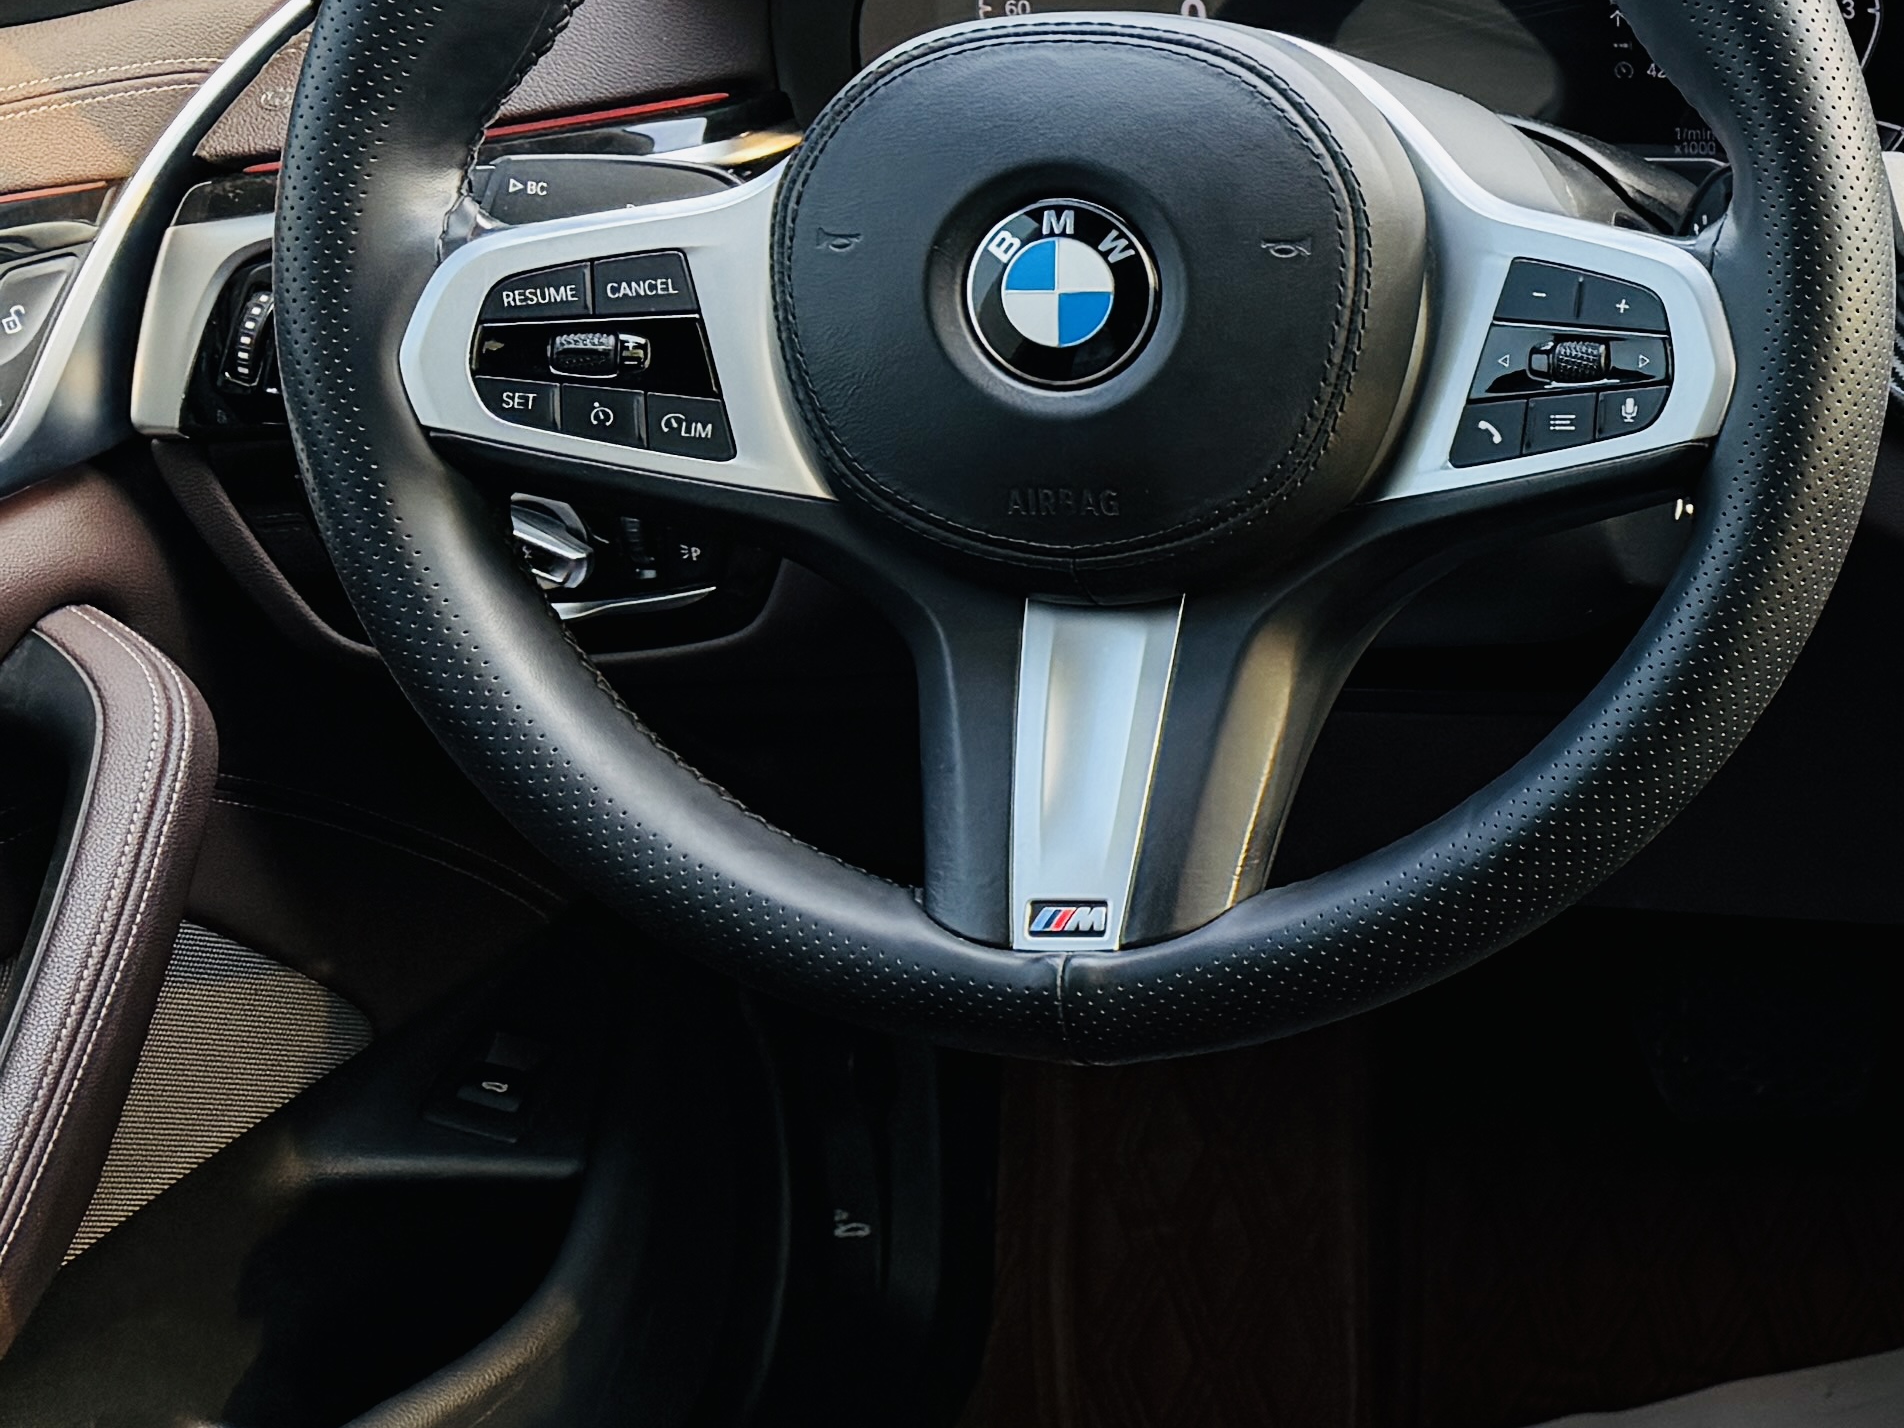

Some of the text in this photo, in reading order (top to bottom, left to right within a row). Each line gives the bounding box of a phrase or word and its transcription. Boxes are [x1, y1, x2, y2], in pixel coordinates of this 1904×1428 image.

[1005, 0, 1031, 16] 60
[1842, 0, 1855, 19] 3
[526, 181, 548, 196] BC
[986, 209, 1136, 264] BMW
[502, 284, 579, 308] RESUME
[606, 278, 679, 299] CANCEL
[502, 392, 536, 410] SET
[680, 421, 712, 439] LIM
[1007, 487, 1120, 517] AIRBAG
